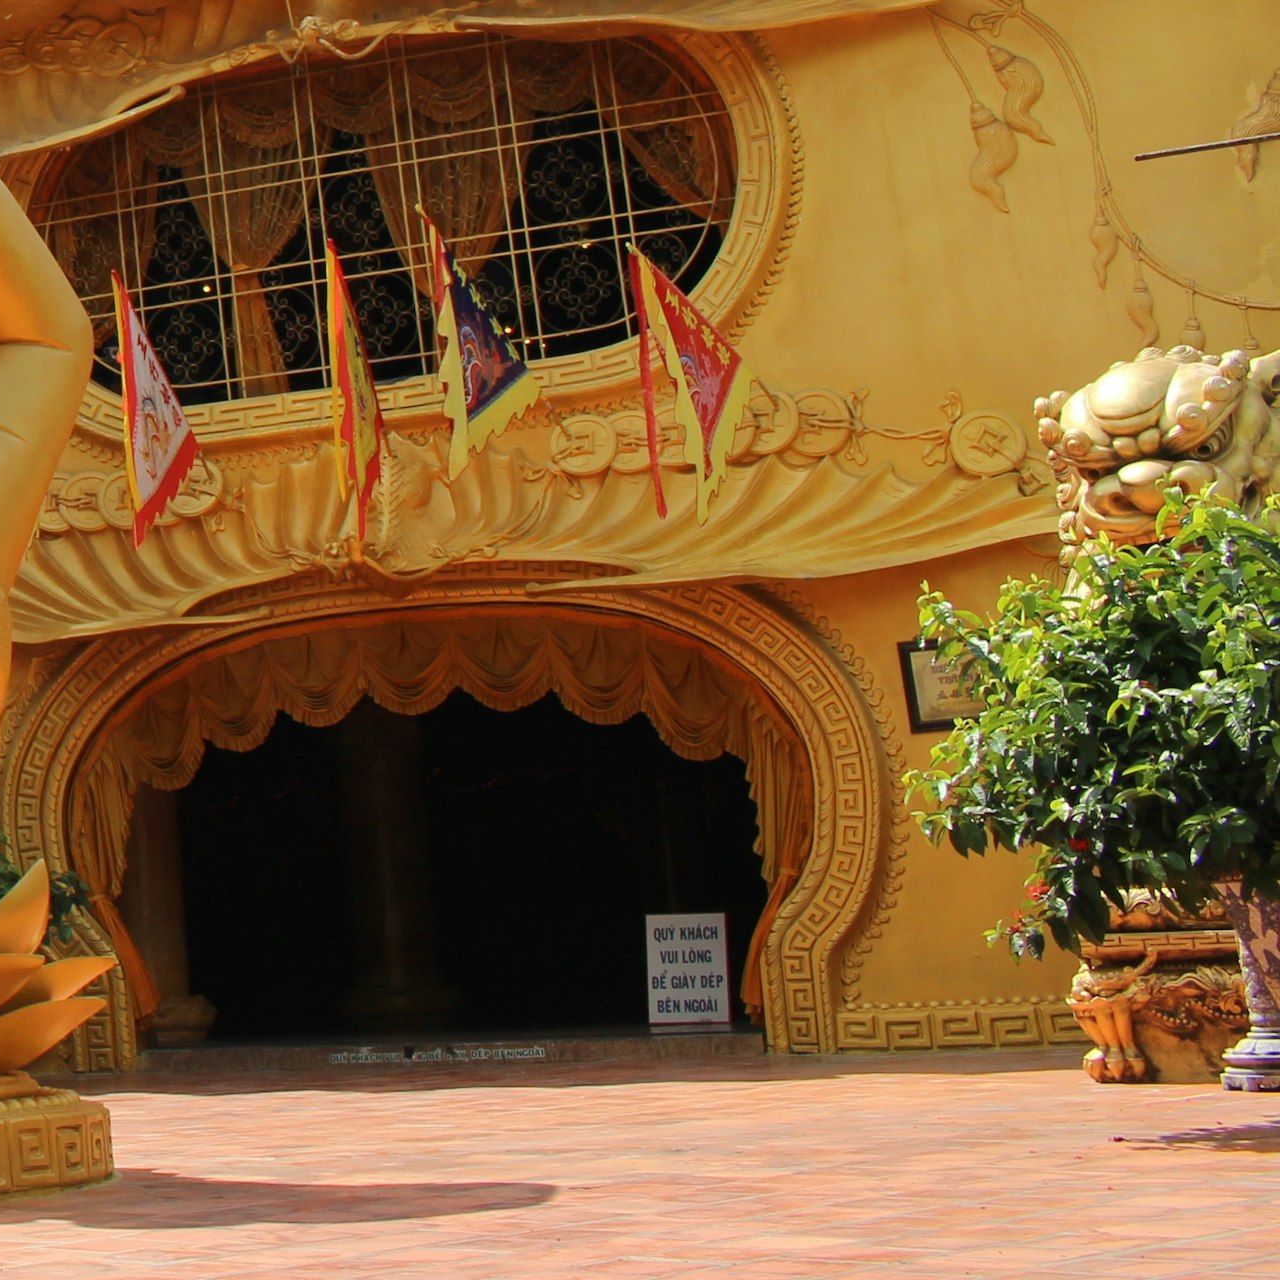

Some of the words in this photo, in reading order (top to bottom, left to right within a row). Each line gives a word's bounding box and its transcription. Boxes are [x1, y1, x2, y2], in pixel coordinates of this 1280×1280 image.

[653, 924, 675, 943] QUÝ
[680, 923, 718, 940] KHÁCH
[660, 950, 678, 964] VUI
[682, 947, 712, 963] LÒNG
[652, 969, 667, 989] ĐỂ
[671, 972, 696, 989] GIÀY
[701, 971, 724, 988] DÉP
[657, 996, 680, 1013] BÊN
[684, 995, 718, 1013] NGOÀI
